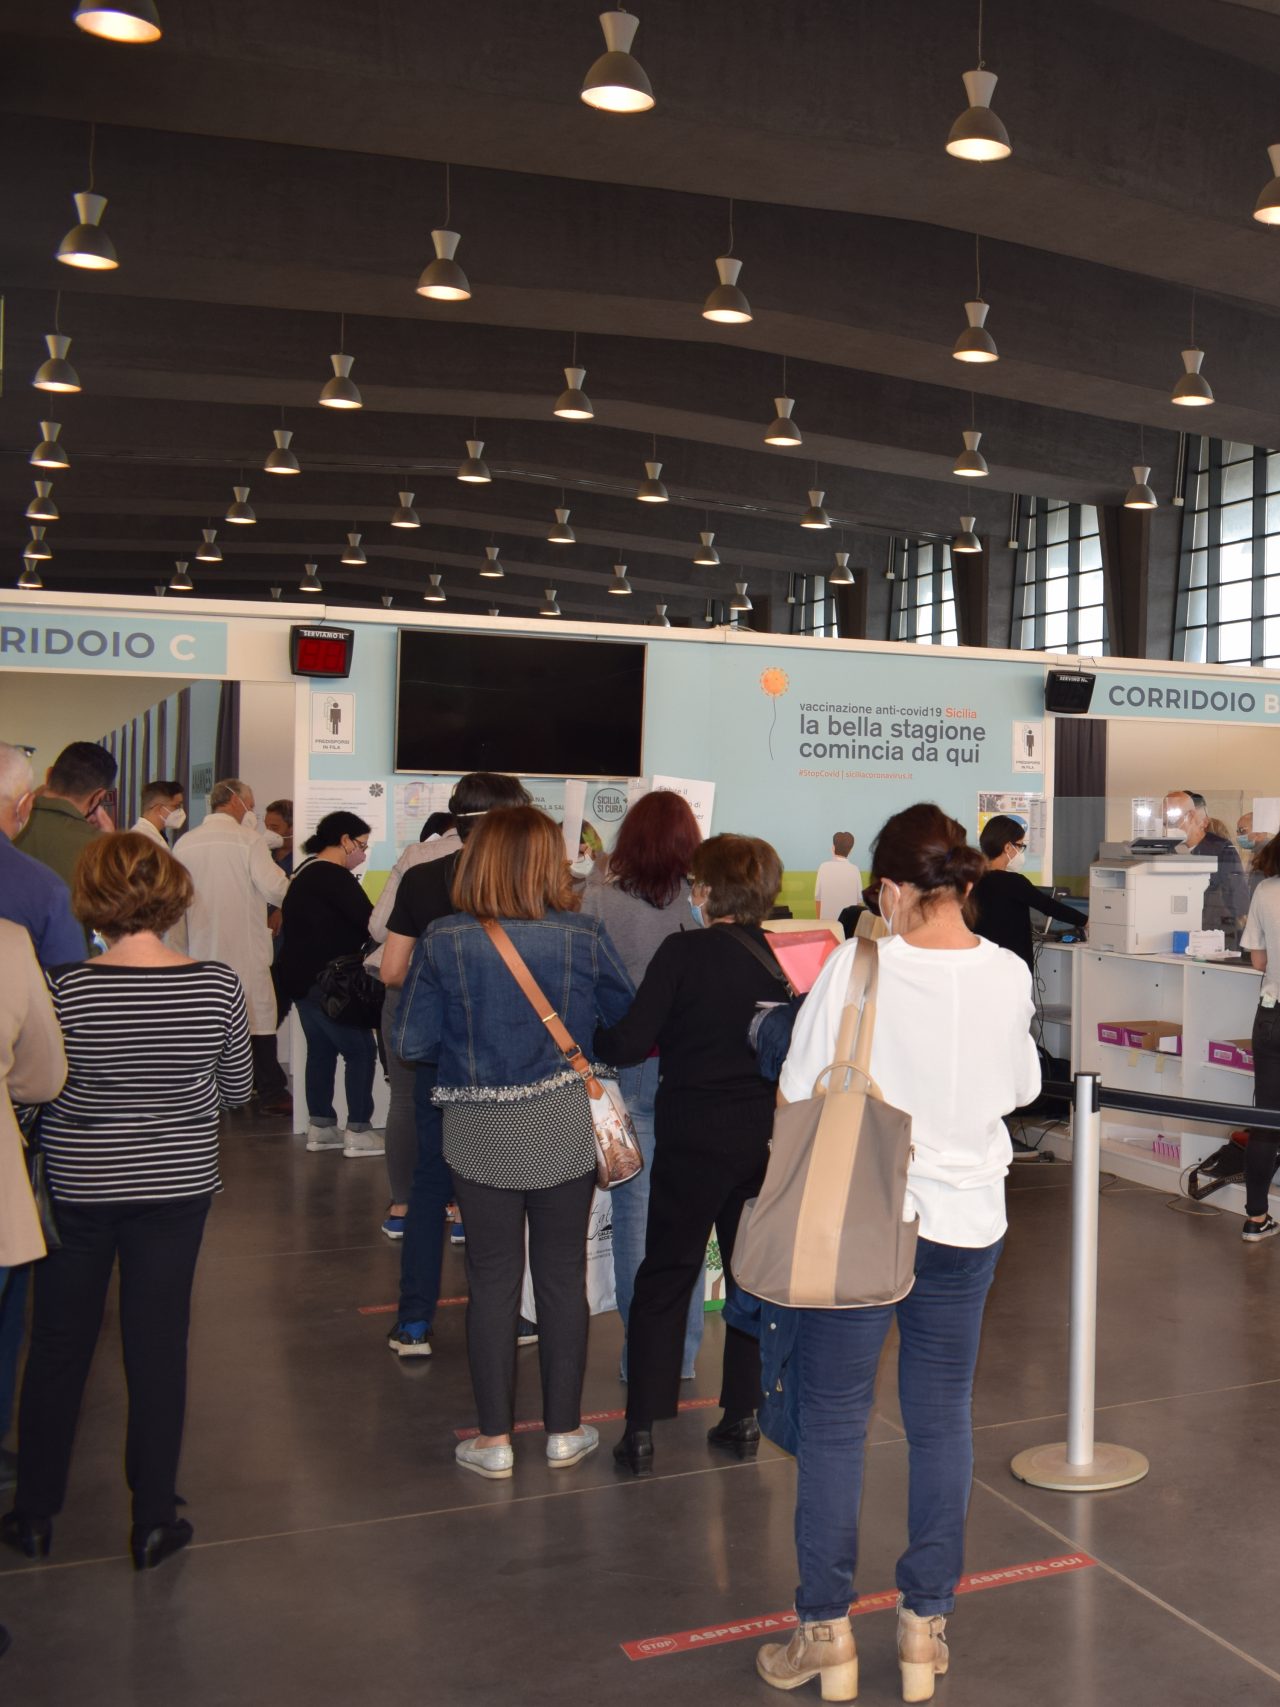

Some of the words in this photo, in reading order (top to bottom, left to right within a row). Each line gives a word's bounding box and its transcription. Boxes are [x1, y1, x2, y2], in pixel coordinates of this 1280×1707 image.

[1, 626, 155, 659] RIDOIO
[169, 634, 196, 661] C
[303, 630, 337, 639] SERVIAMO
[800, 702, 872, 714] vaccinazione
[875, 704, 942, 717] anti-covid19
[945, 707, 977, 719] Sicilia
[1108, 685, 1255, 713] CORRIDOIO
[1264, 694, 1280, 714] B
[800, 714, 819, 735] la
[828, 715, 882, 737] bella
[890, 719, 986, 744] stagione
[799, 739, 904, 761] comincia
[912, 742, 938, 762] da
[946, 744, 980, 767] qui
[597, 796, 620, 805] SICILIA
[597, 805, 603, 813] SI
[605, 805, 623, 813] CURA
[969, 1565, 1048, 1586] ASPETTA
[1050, 1557, 1083, 1568] QUI
[642, 1640, 672, 1651] STOP
[689, 1619, 780, 1642] ASPETTA
